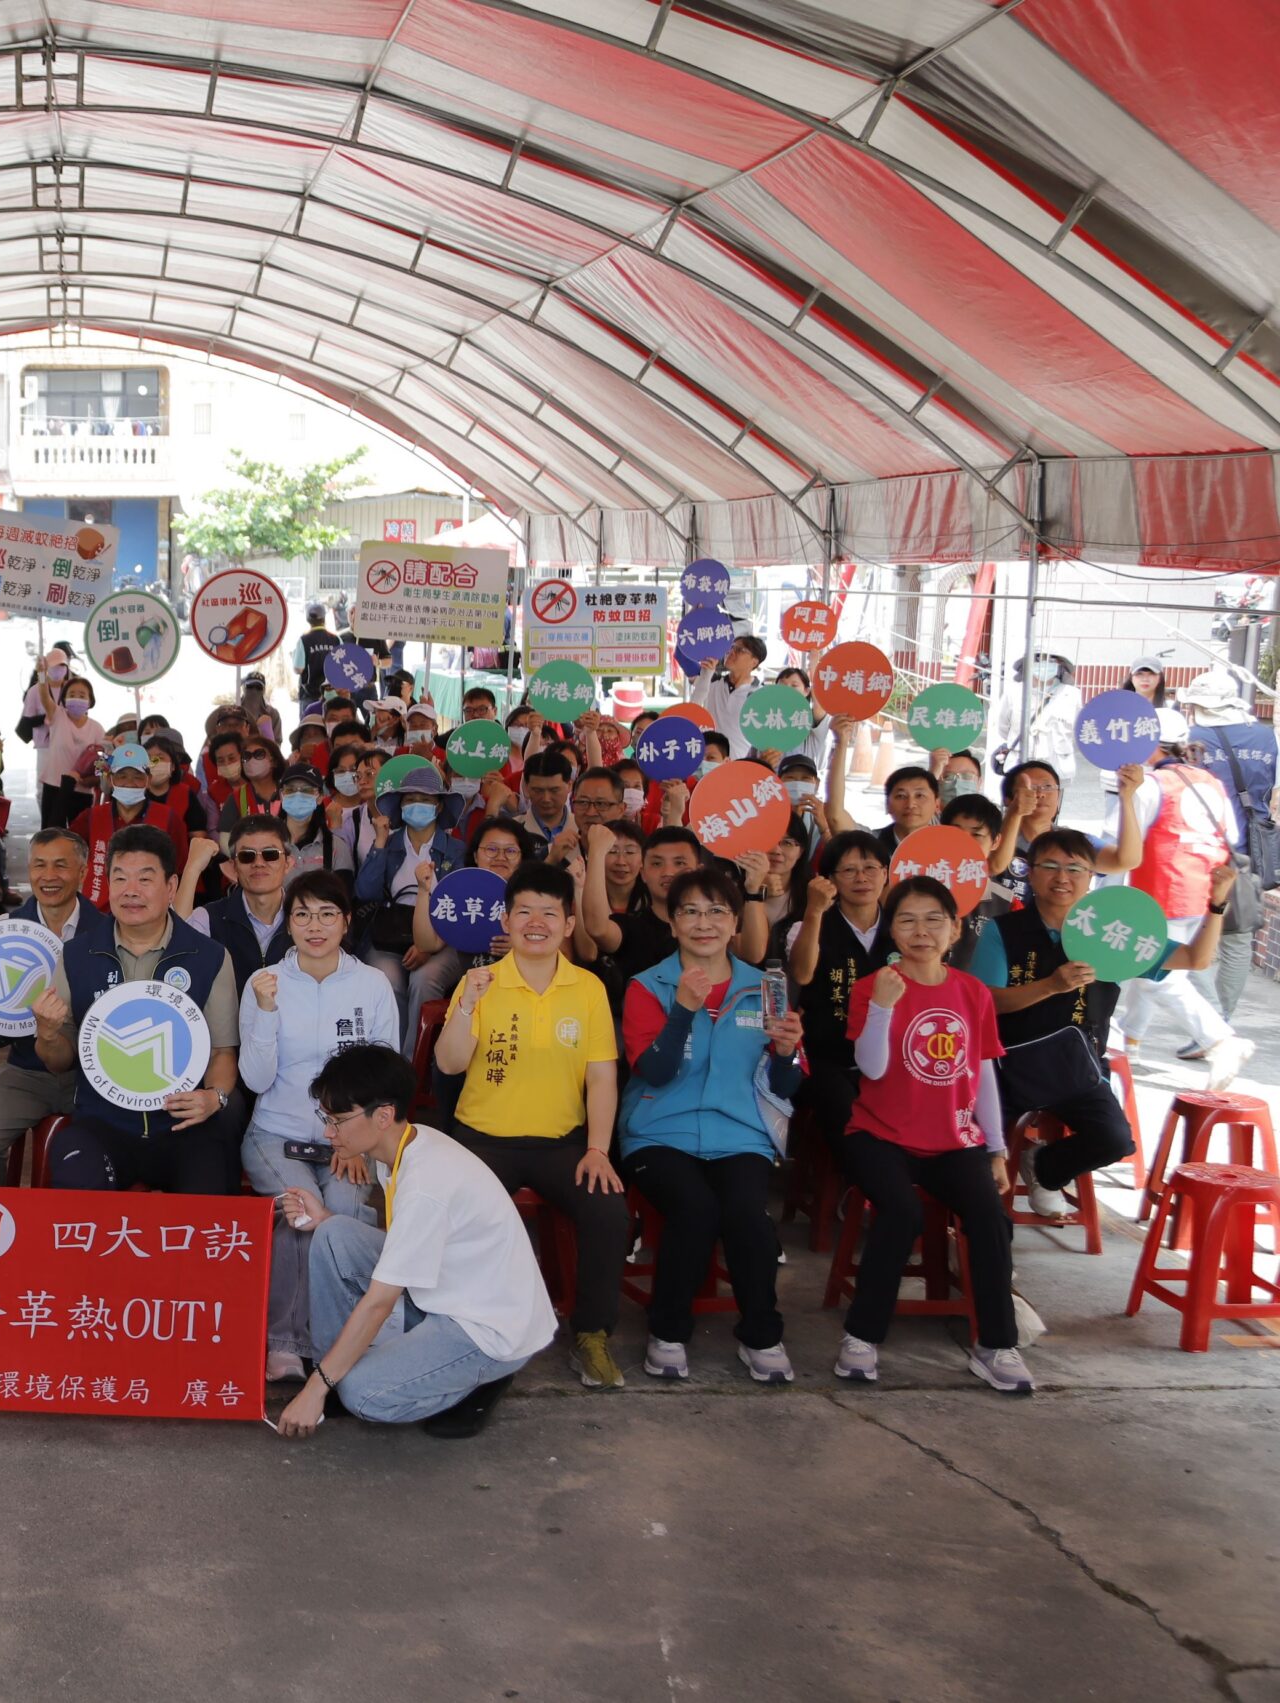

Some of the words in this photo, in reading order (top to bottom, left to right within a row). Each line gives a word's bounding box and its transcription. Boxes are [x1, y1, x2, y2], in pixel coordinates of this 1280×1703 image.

[403, 559, 479, 588] 請配合
[683, 573, 729, 594] 布袋鎮
[585, 593, 657, 606] 杜絕登革熱
[593, 610, 651, 622] 防蚊四招
[680, 624, 733, 646] 六腳鄉
[530, 678, 594, 704] 新港鄉
[819, 665, 892, 698] 中埔鄉
[742, 707, 813, 732] 大林鎮
[909, 705, 983, 731] 民雄鄉
[1078, 714, 1159, 746] 義竹鄉
[449, 737, 509, 763] 水上鄉
[639, 737, 703, 763] 朴子市
[698, 775, 784, 844] 梅山鄉
[894, 859, 987, 889] 竹崎鄉
[1067, 905, 1161, 963] 太保市
[145, 984, 200, 1023] 環境部
[509, 1013, 519, 1061] 嘉義縣議員
[82, 1015, 100, 1072] Ministry
[93, 1075, 109, 1089] of
[53, 1216, 253, 1262] 四大口訣
[181, 1378, 245, 1406] 廣告
